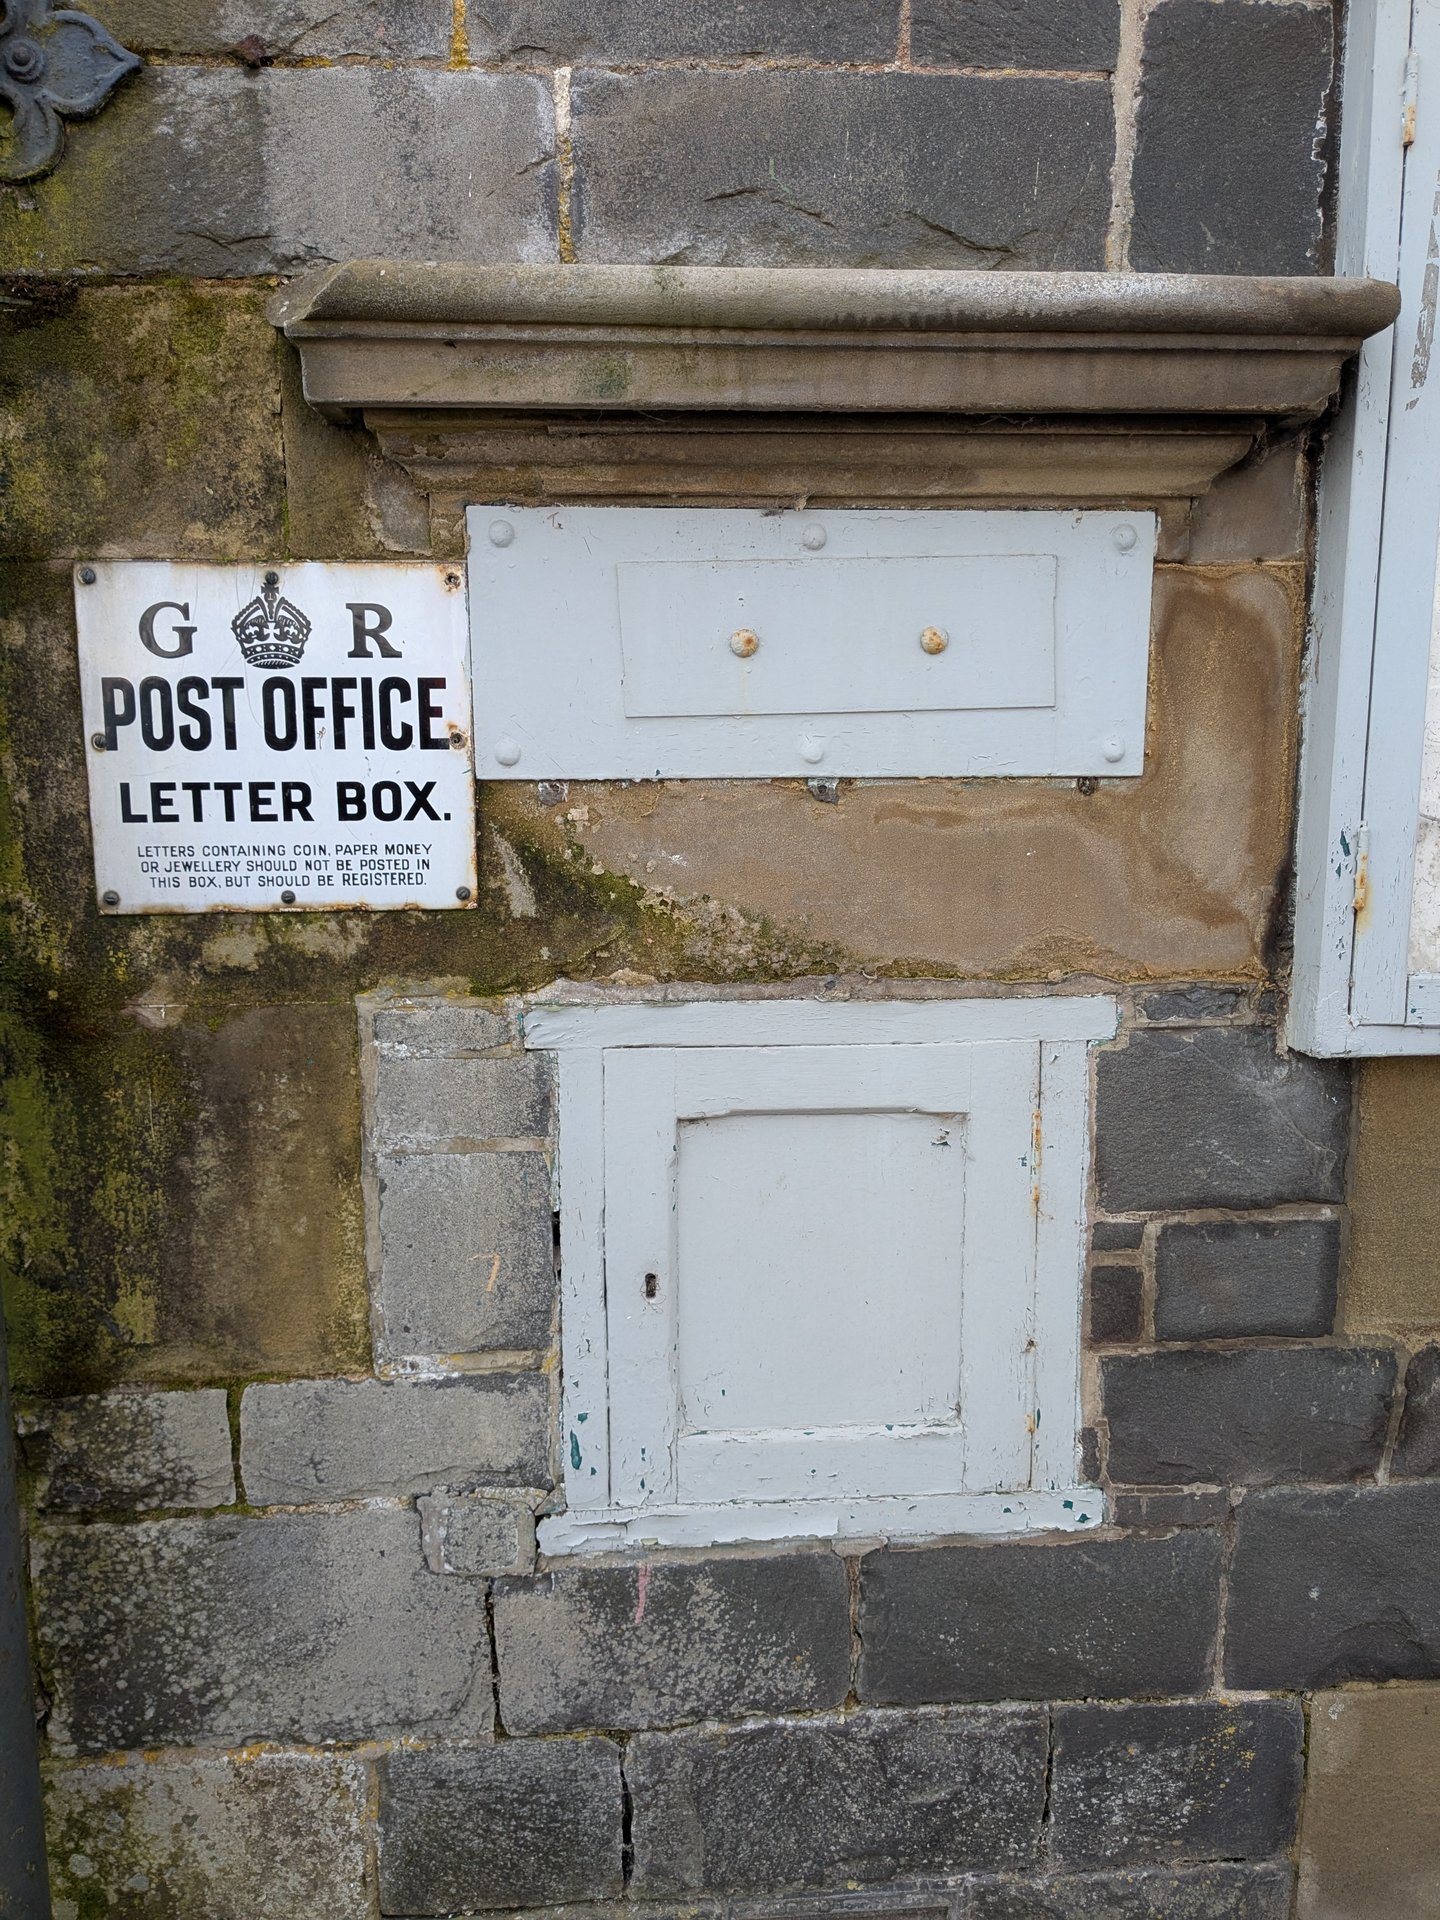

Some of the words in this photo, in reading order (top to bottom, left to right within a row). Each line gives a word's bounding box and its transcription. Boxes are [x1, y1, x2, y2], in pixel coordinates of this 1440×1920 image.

[139, 601, 197, 659] G
[345, 602, 402, 659] R
[101, 675, 245, 752] POST
[262, 675, 451, 752] OFFICE
[119, 781, 315, 824] LETTER
[336, 780, 452, 822] BOX.
[137, 845, 195, 858] LETTERS
[202, 844, 286, 857] CONTAINING
[293, 844, 331, 857] COIN,
[335, 844, 378, 856] PAPER
[384, 843, 432, 856] MONEY
[140, 860, 160, 873] OR
[164, 860, 241, 873] JEWELLERY
[246, 859, 298, 872] SHOULD
[304, 859, 330, 871] NOT
[336, 859, 353, 871] BE
[359, 858, 410, 871] POSTED
[416, 858, 430, 870] IN
[149, 876, 181, 889] THIS
[188, 875, 222, 888] BOX,
[224, 875, 251, 888] BUT
[257, 874, 311, 887] SHOULD
[317, 874, 335, 887] BE
[342, 872, 427, 887] REGISTERED.
